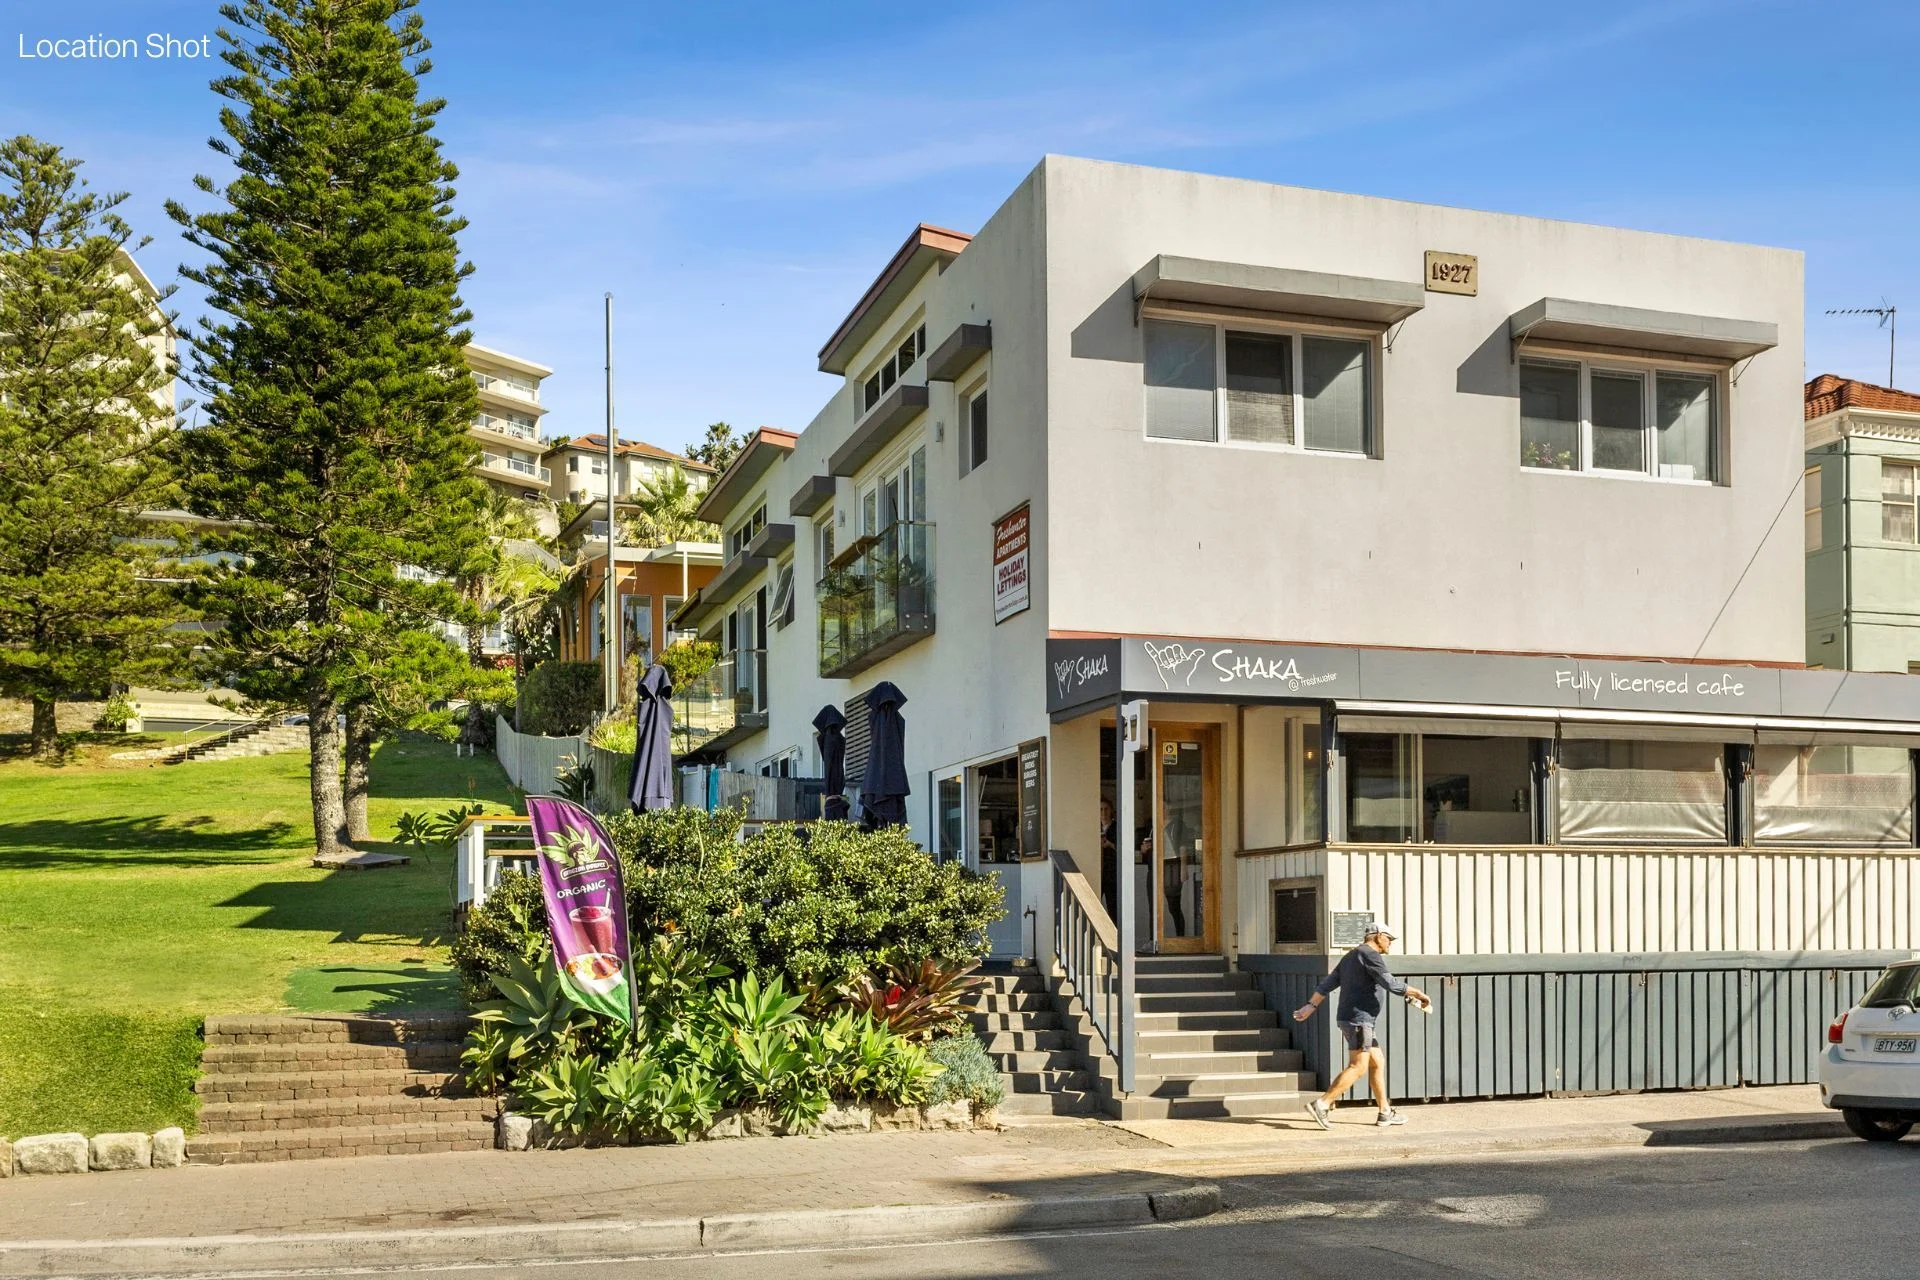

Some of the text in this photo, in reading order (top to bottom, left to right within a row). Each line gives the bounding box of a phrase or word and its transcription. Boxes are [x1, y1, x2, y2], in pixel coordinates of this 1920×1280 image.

[1432, 262, 1472, 283] 1927
[997, 518, 1026, 545] Freshwater
[996, 533, 1027, 560] APARTMENTS
[998, 556, 1024, 578] HOLIDAY
[997, 569, 1026, 595] LETTINGS
[1076, 654, 1108, 685] SHAKA
[1212, 649, 1302, 682] SHAKA
[1555, 670, 1745, 700] Fully licensed cafe
[557, 879, 606, 898] ORGANIC
